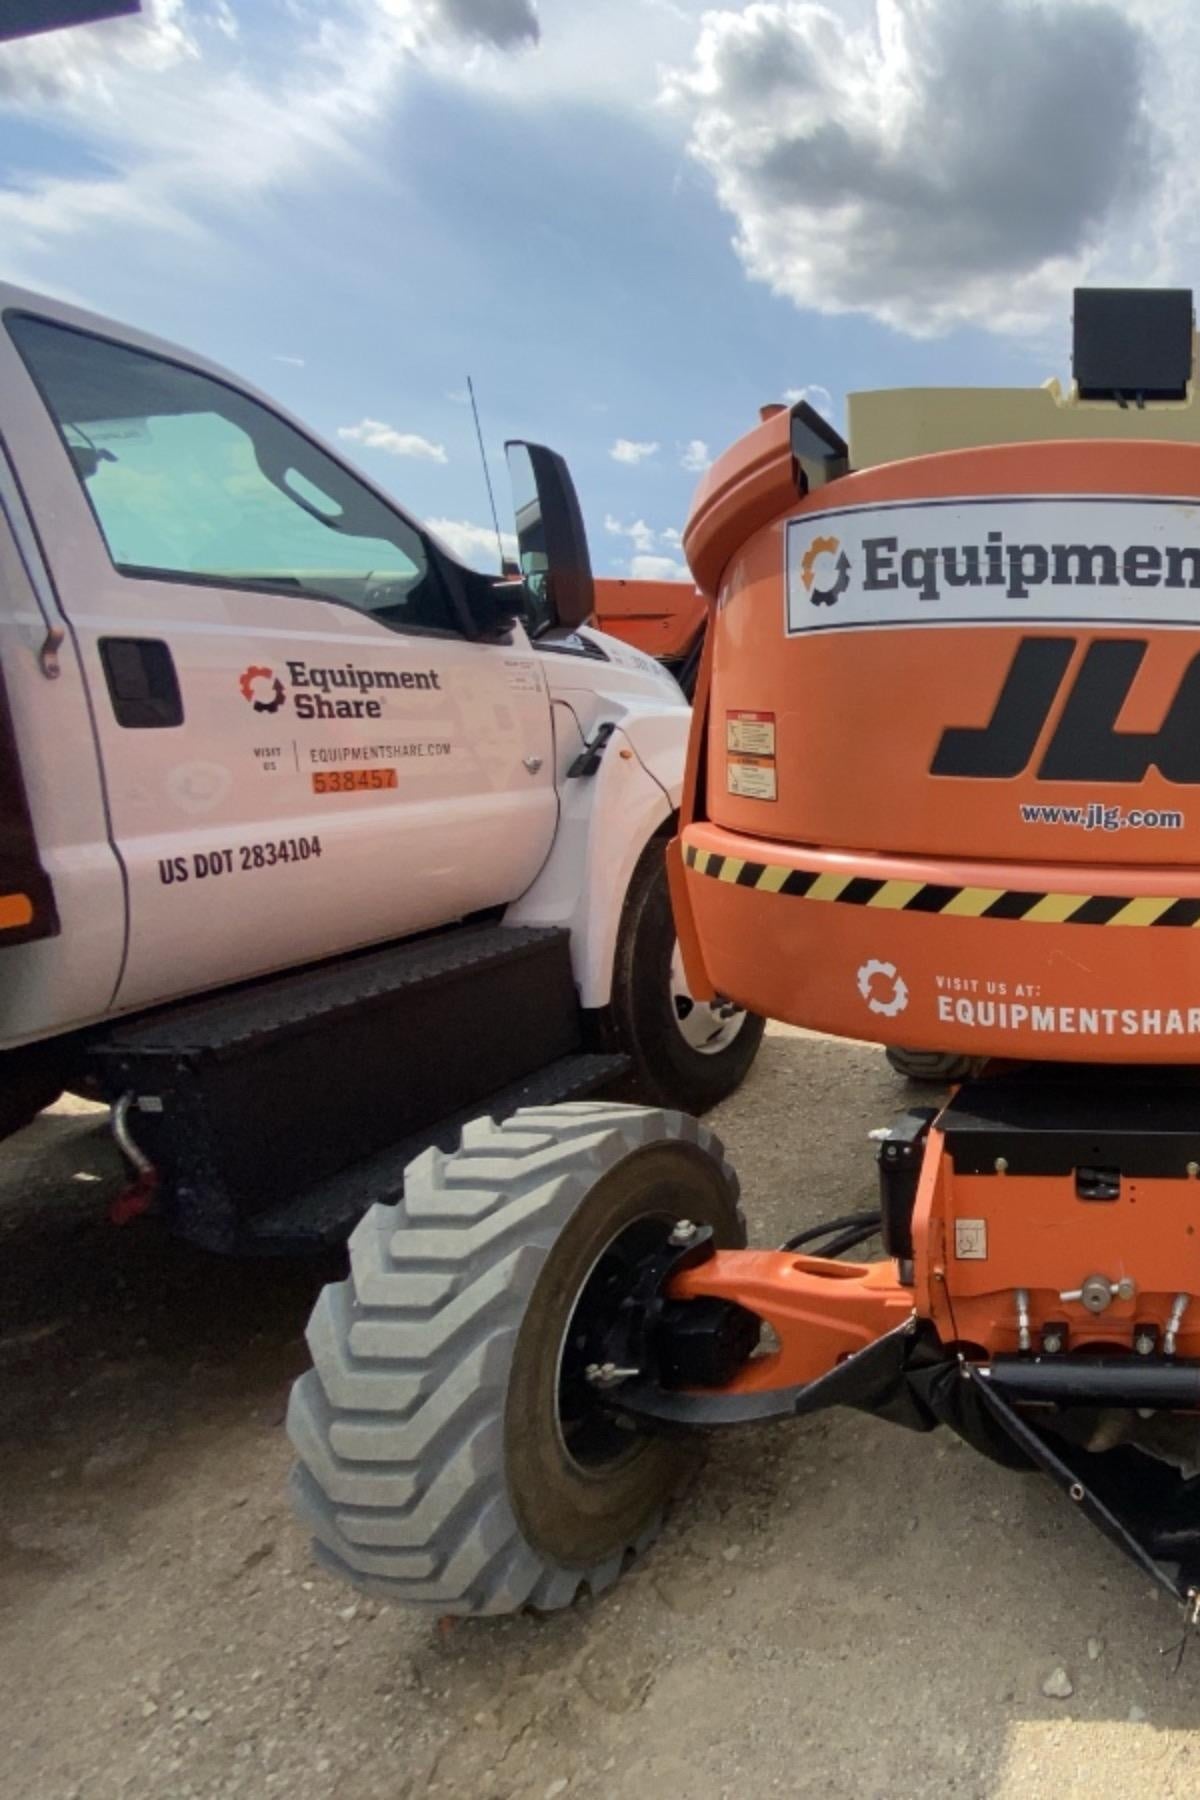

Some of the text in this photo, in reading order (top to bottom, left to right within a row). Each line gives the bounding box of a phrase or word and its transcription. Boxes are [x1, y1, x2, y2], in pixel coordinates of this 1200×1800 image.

[286, 661, 442, 694] Equipment
[294, 693, 383, 719] Share
[253, 747, 281, 758] VISIT
[310, 743, 452, 763] EQUIPMENTSHARE.COM
[313, 770, 396, 792] 538457
[1020, 803, 1183, 832] www.jlg.com
[158, 835, 322, 885] US DOT 2834104
[936, 975, 1041, 998] VISIT US AT:
